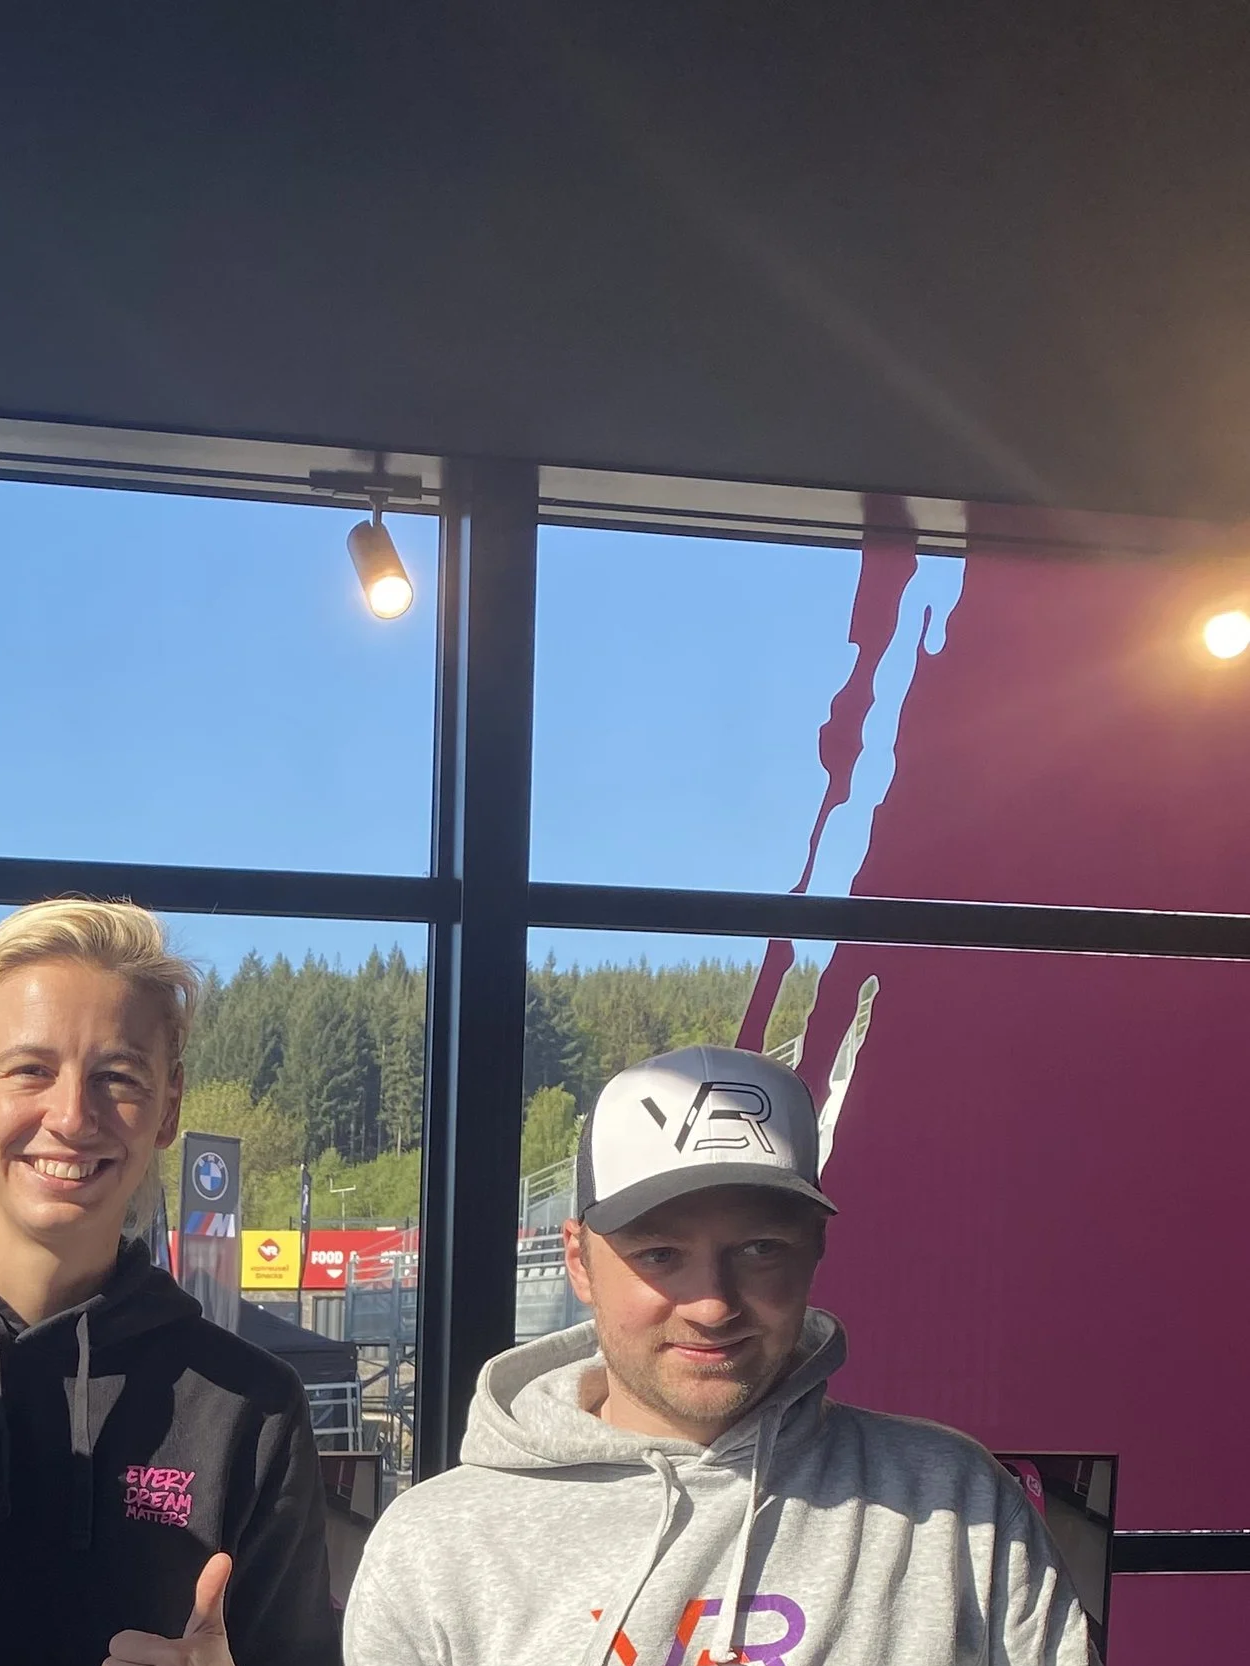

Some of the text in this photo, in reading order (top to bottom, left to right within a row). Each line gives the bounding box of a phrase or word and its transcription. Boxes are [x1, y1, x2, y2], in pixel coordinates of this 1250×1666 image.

[311, 1250, 344, 1264] FOOD
[126, 1465, 196, 1493] EVERY
[123, 1486, 192, 1515] DREAM
[125, 1505, 188, 1528] MATTERS
